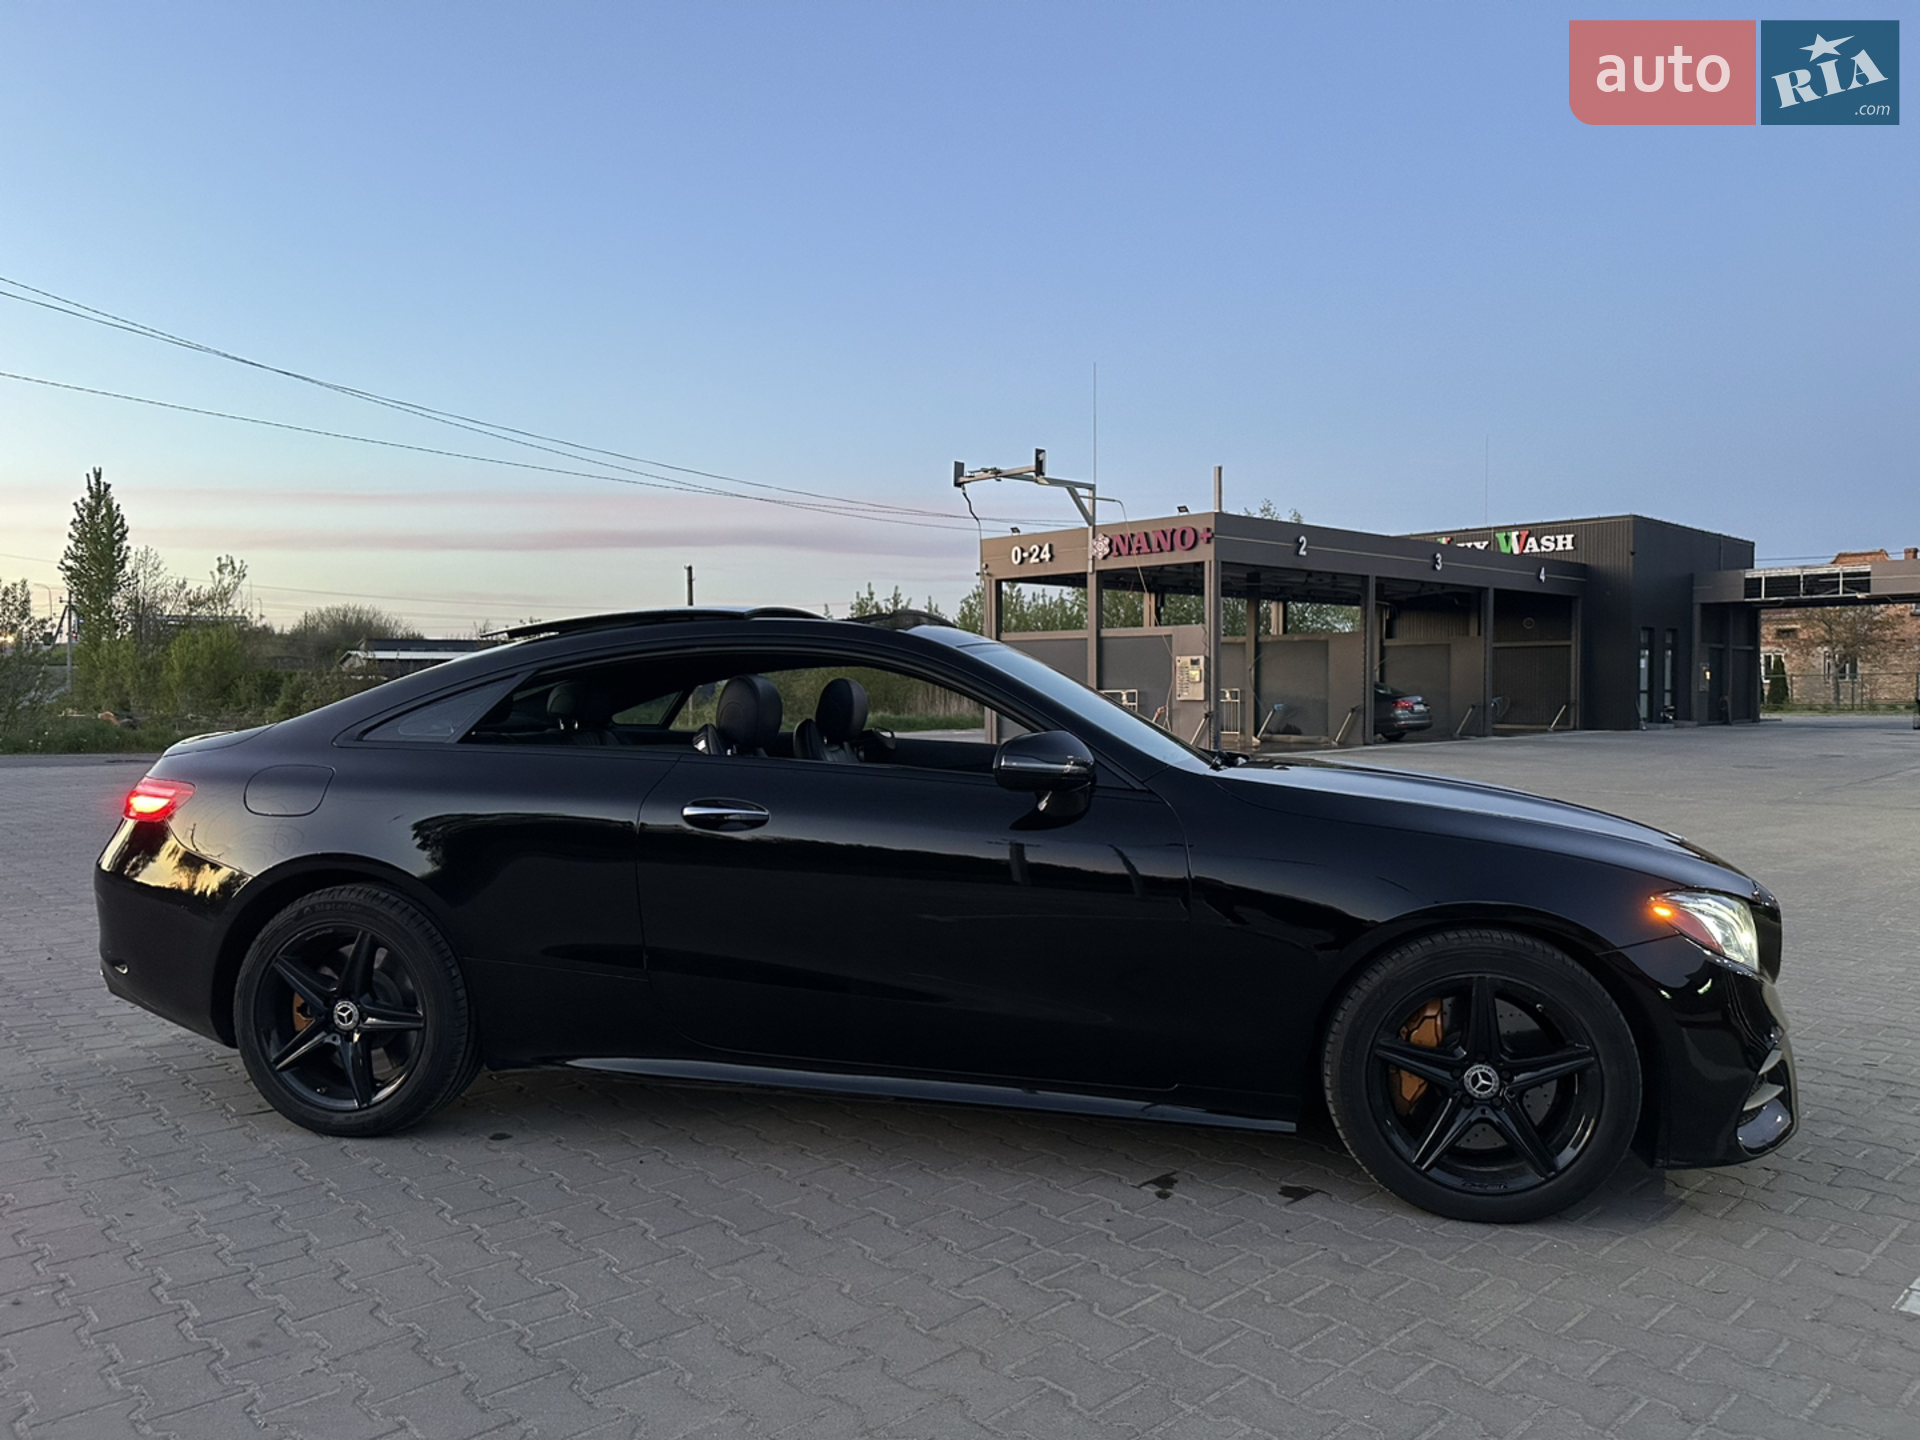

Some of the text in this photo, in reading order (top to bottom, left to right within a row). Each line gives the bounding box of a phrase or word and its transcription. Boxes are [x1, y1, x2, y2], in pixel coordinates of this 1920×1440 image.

[1298, 535, 1308, 556] 2
[1495, 530, 1575, 555] WASH
[1011, 542, 1052, 565] 0-24
[1434, 552, 1443, 571] 3
[1538, 566, 1546, 583] 4
